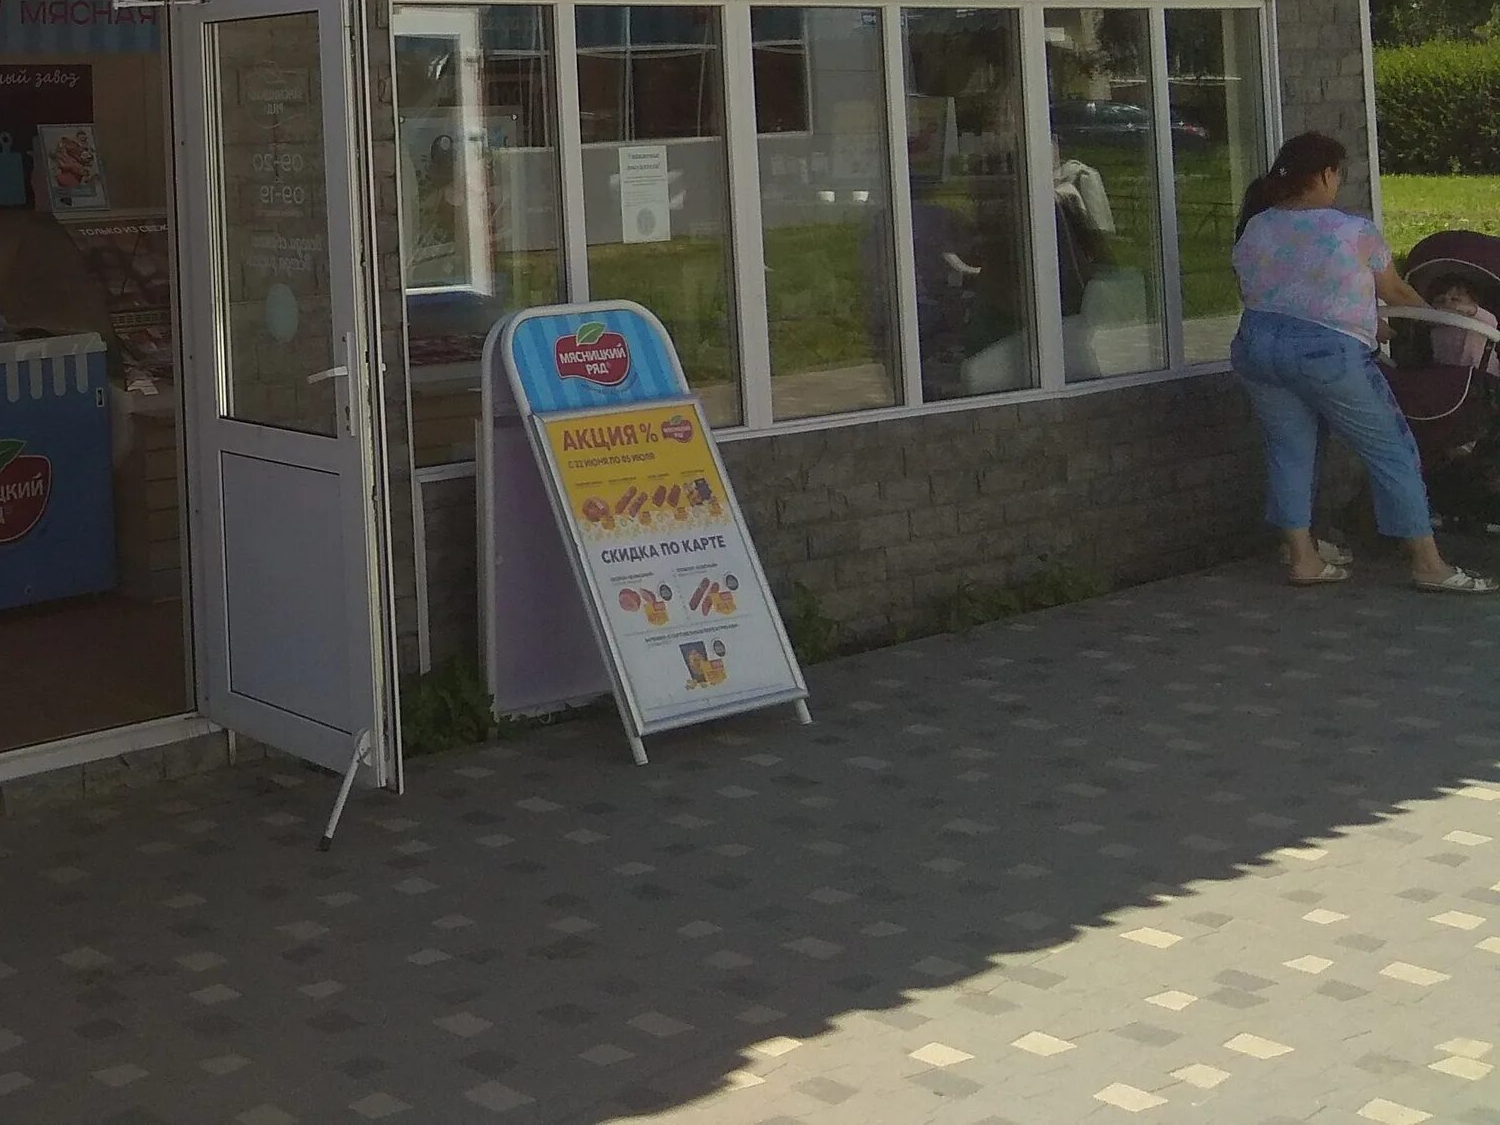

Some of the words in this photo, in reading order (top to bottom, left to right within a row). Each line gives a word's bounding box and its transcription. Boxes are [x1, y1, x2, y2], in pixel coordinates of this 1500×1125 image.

[35, 73, 80, 88] завоз
[559, 342, 626, 364] МЯСНИЦКИЙ
[586, 362, 609, 375] РЯД
[563, 424, 639, 451] АКЦИЯ
[601, 545, 658, 564] СКИДКА
[660, 541, 680, 556] ПО
[682, 535, 727, 553] КАРТЕ
